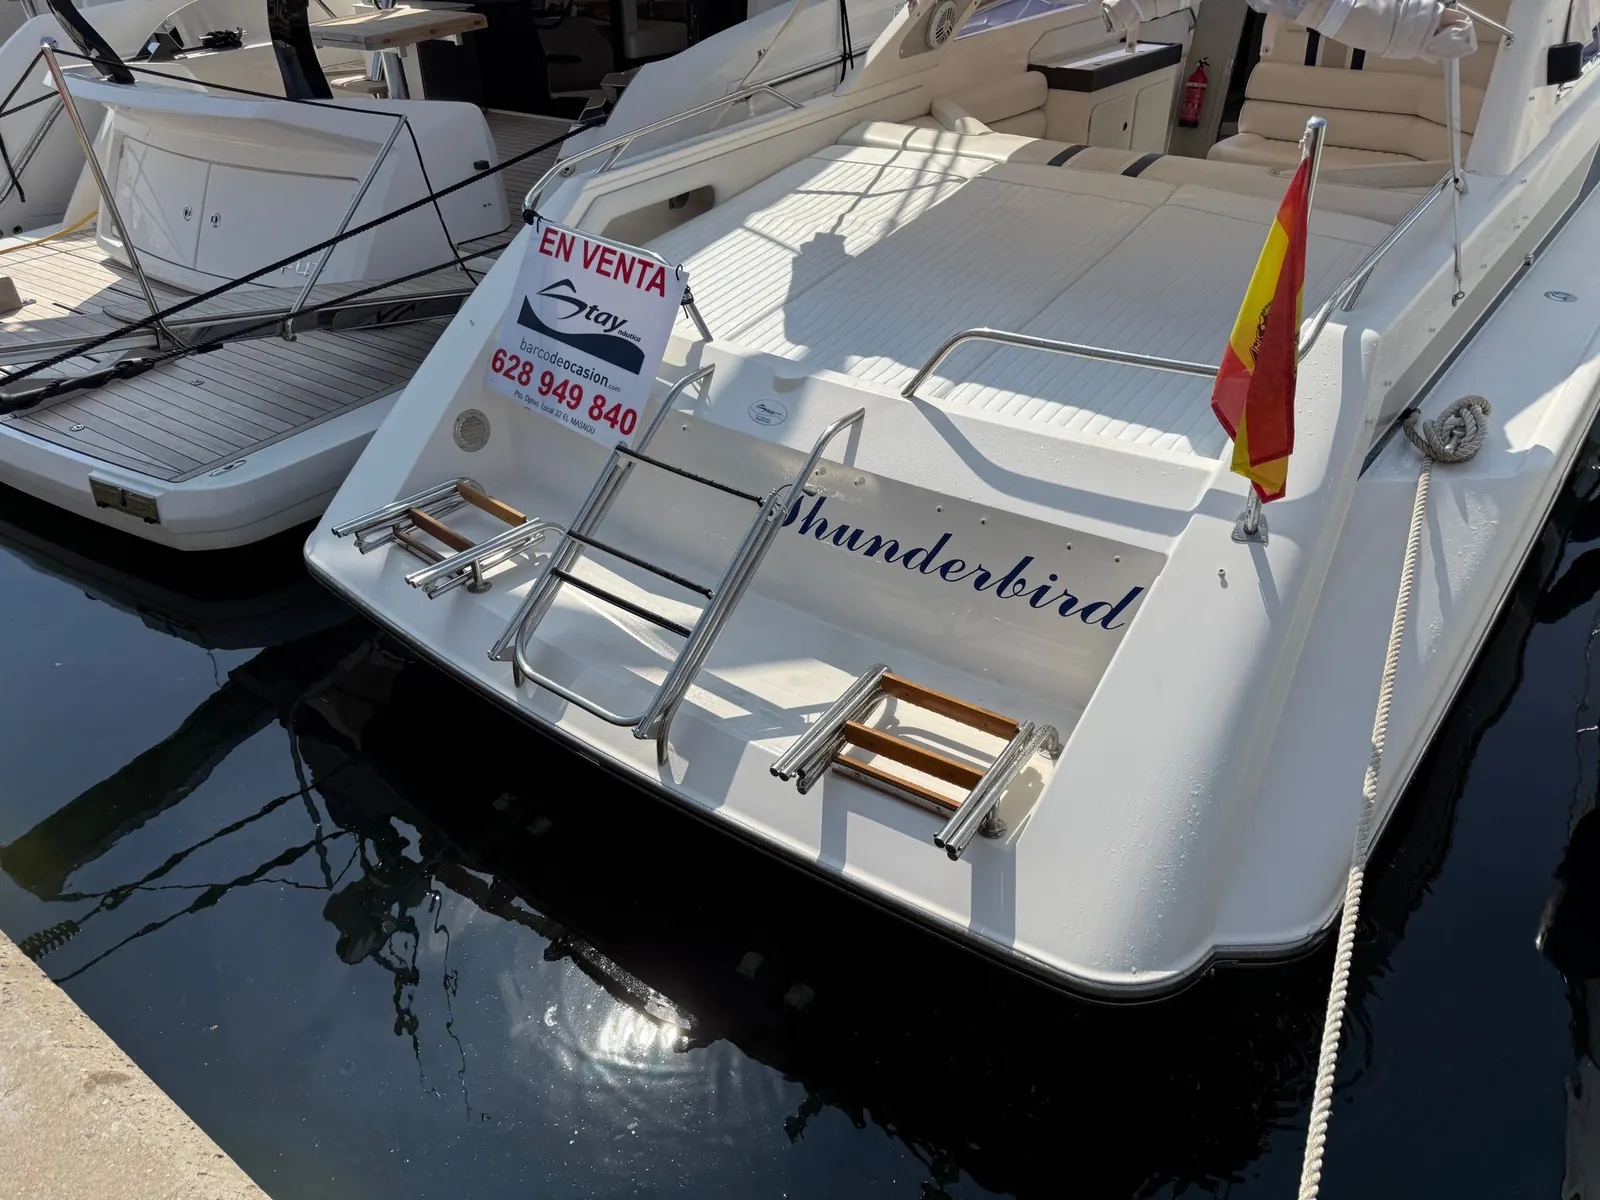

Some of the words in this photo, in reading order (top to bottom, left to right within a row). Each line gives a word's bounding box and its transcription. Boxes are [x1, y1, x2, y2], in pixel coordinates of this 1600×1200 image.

[538, 226, 576, 263] EN
[582, 239, 667, 298] VENTA
[536, 278, 628, 333] Stay
[617, 329, 642, 343] náutica
[491, 348, 534, 387] 628
[537, 370, 584, 410] 949
[588, 394, 638, 436] 840
[519, 337, 621, 393] barcodeocasion.com
[540, 402, 555, 414] Local
[554, 409, 562, 419] 32
[562, 413, 569, 422] EL
[570, 417, 596, 435] MASNOU
